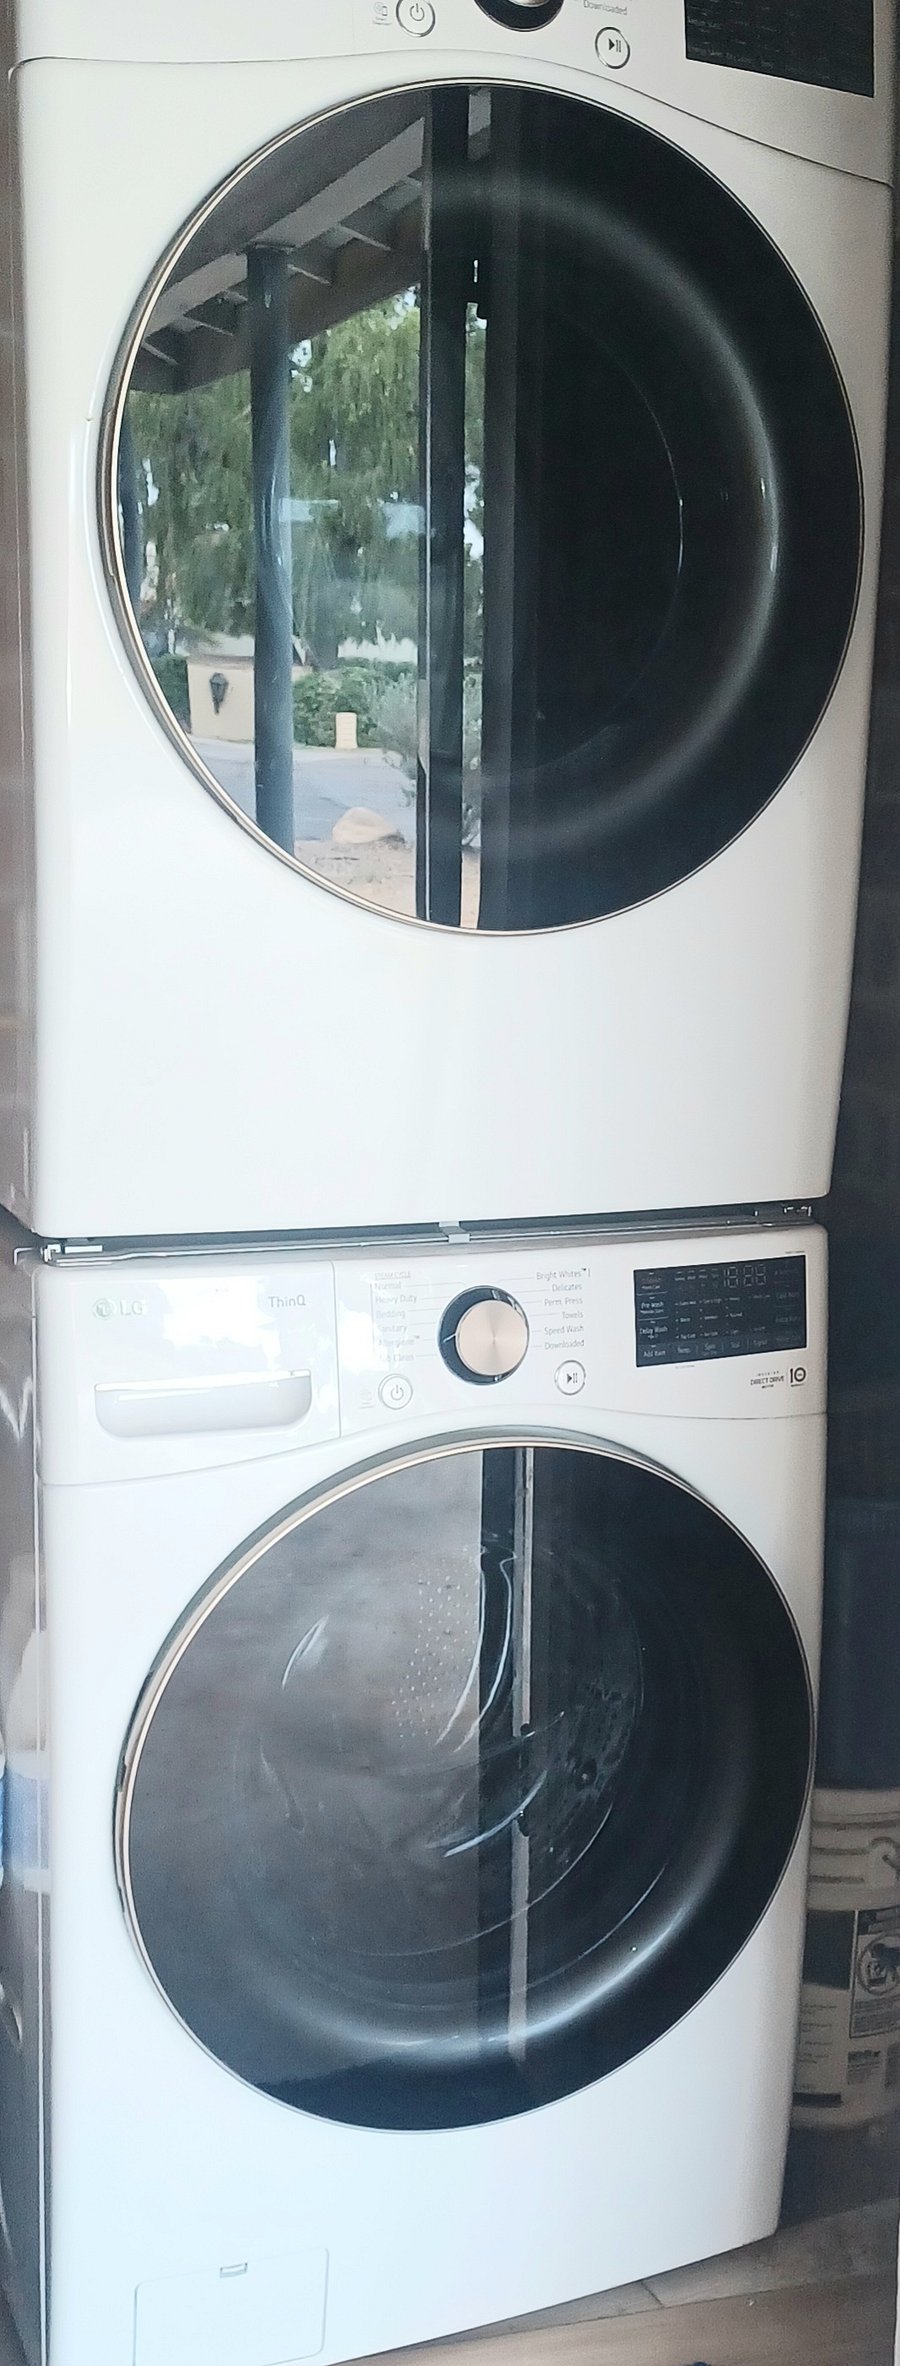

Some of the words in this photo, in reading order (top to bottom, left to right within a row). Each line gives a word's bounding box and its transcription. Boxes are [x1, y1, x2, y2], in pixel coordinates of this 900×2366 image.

[536, 1271, 557, 1282] Bright
[552, 1283, 583, 1292] Delicates
[267, 1294, 307, 1309] ThinQ
[375, 1295, 399, 1304] Heavy
[400, 1294, 418, 1304] Duty
[565, 1296, 583, 1305] Press
[118, 1300, 144, 1316] LG
[562, 1310, 584, 1319] Towels
[544, 1326, 565, 1336] Speed
[566, 1325, 584, 1333] Wash
[544, 1339, 585, 1350] Downloaded
[790, 1367, 807, 1383] 10
